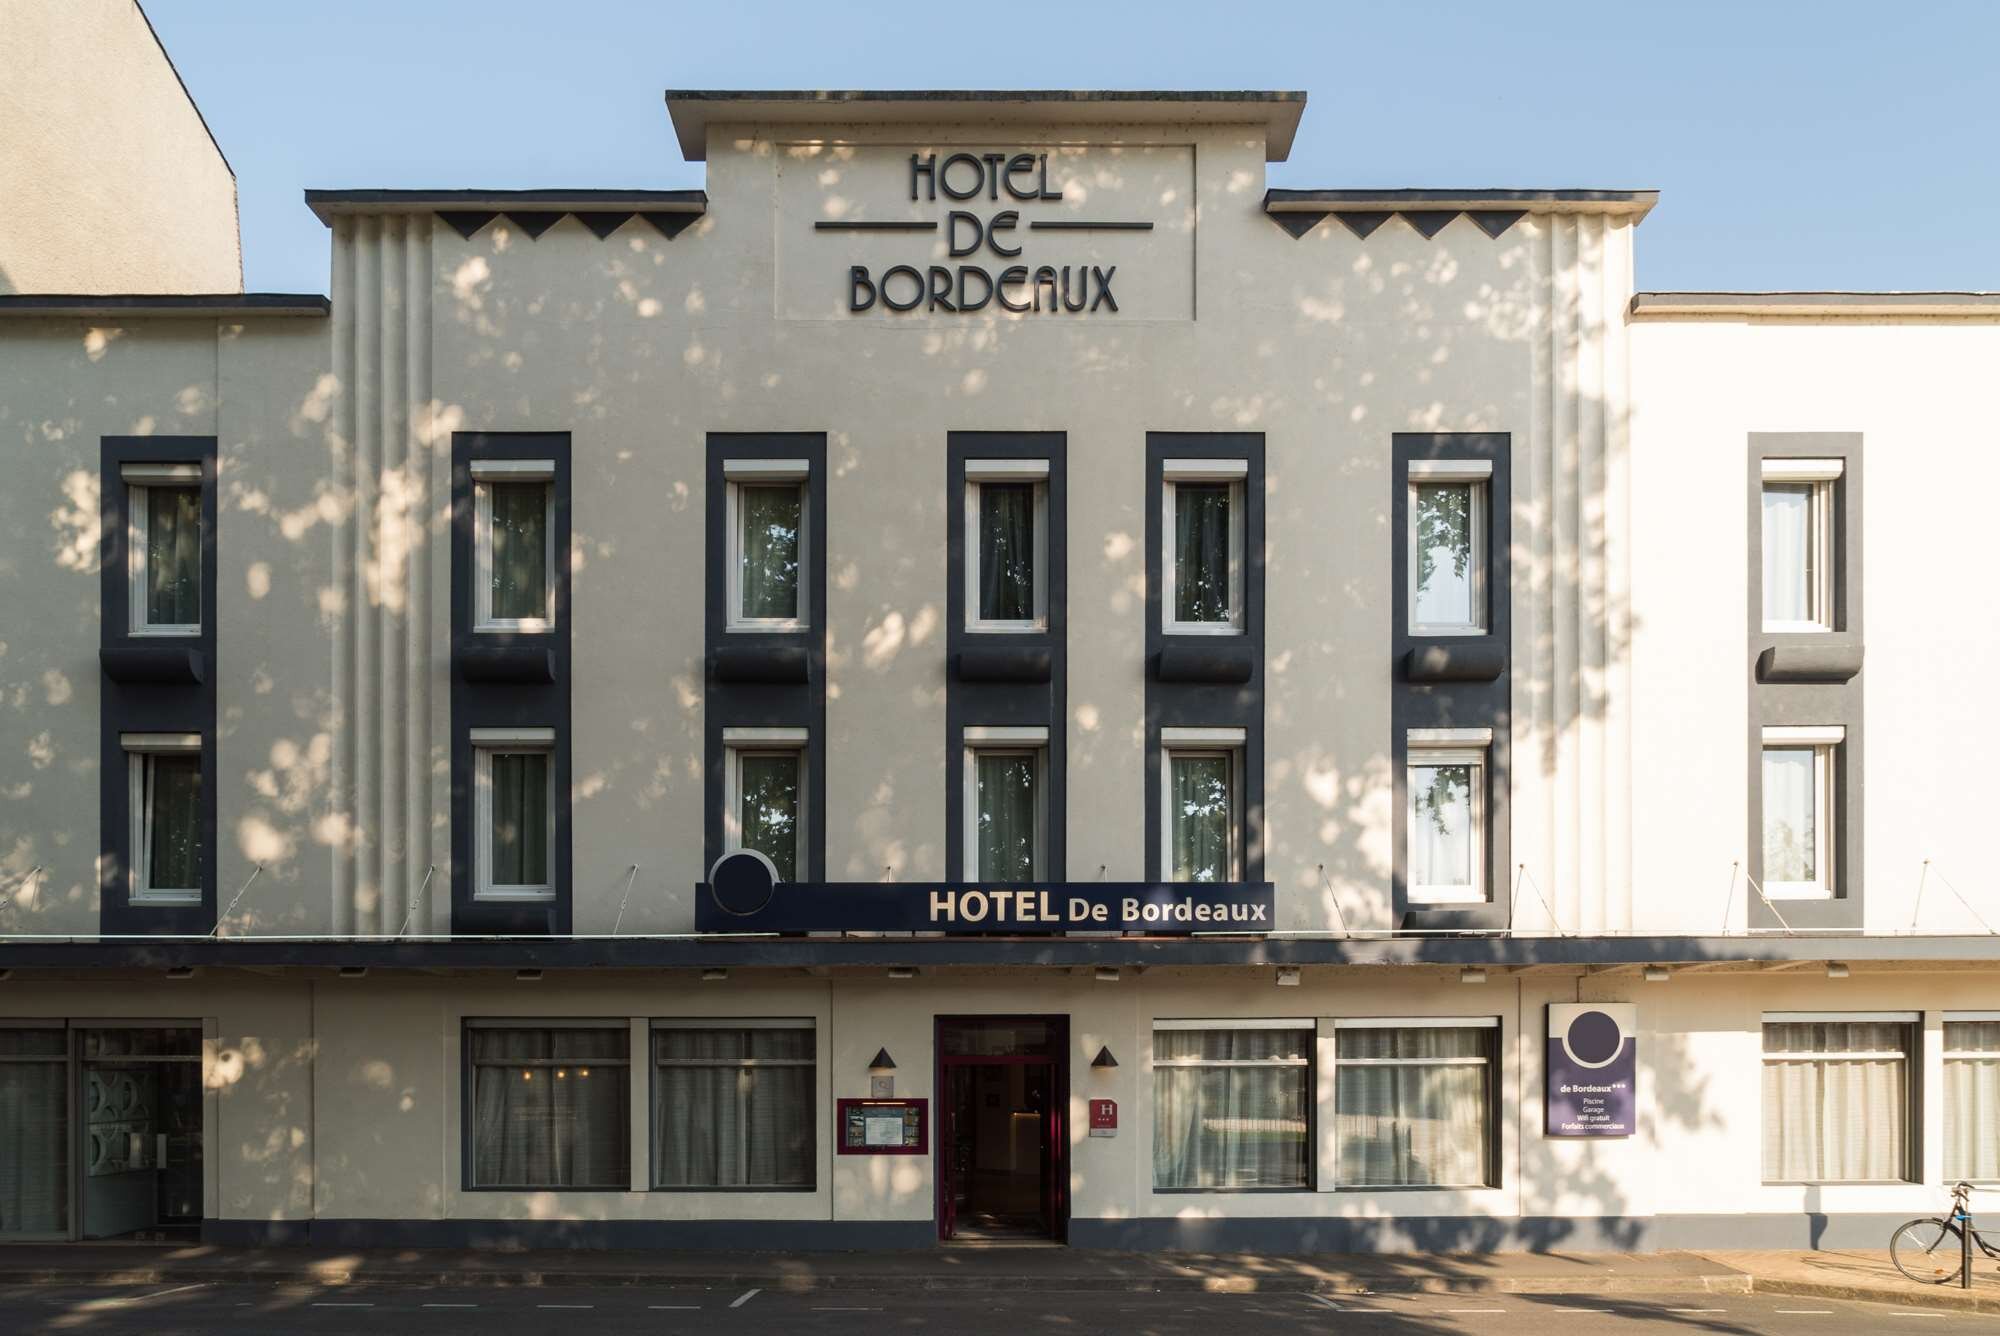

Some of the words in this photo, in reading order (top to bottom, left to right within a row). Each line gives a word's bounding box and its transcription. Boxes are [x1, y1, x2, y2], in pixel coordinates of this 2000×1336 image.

[911, 153, 1063, 201] HOTEL
[949, 210, 1022, 257] DE
[849, 265, 1119, 312] BORDEAUX
[930, 890, 1060, 922] HOTEL
[1068, 898, 1108, 922] De
[1122, 896, 1266, 922] Bordeaux
[1560, 1084, 1571, 1093] de
[1572, 1084, 1612, 1093] Bordeaux
[1582, 1106, 1605, 1114] Garage
[1583, 1097, 1605, 1105] Piscine
[1589, 1114, 1610, 1123] gratuit
